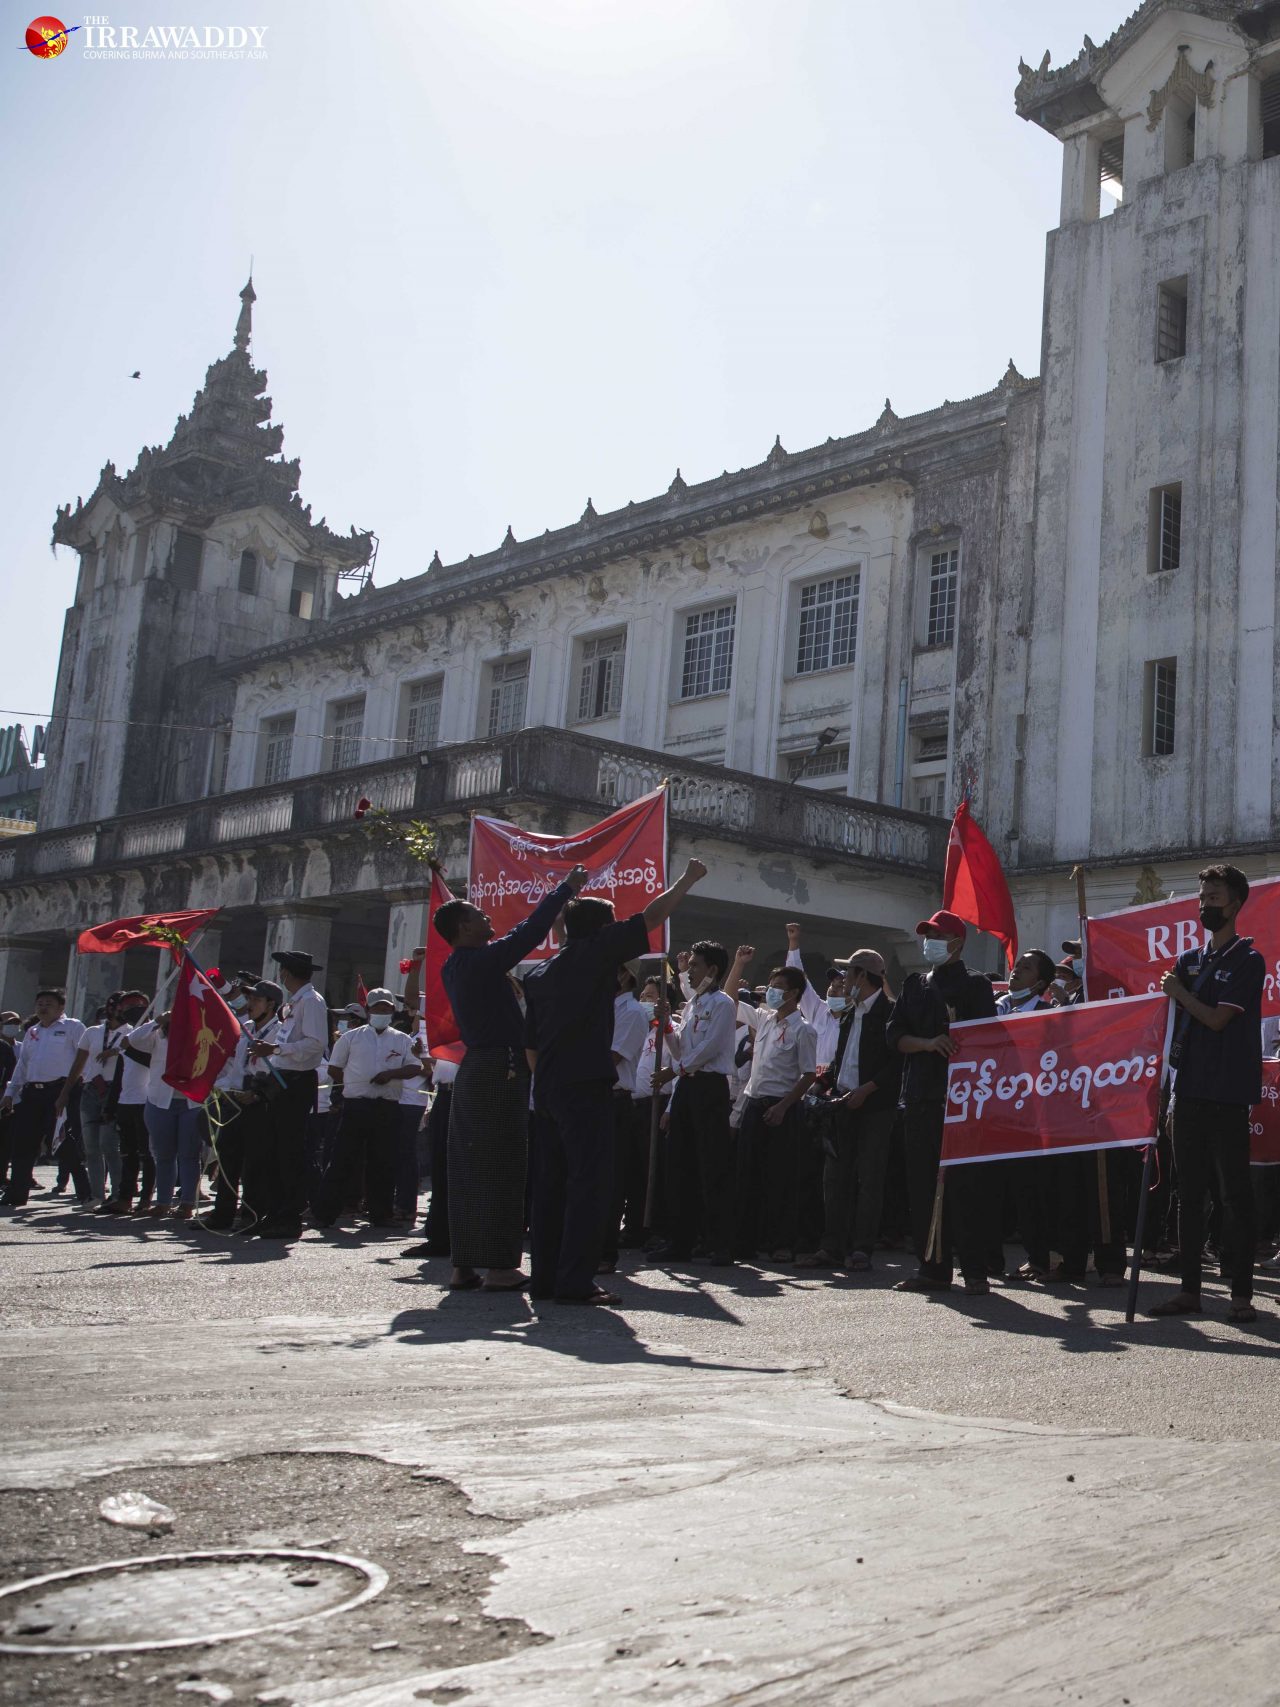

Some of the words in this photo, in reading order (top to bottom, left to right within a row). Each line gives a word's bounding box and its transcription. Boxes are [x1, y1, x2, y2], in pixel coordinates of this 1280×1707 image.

[944, 1050, 1158, 1124] မြန်မာ့မီးရထား
